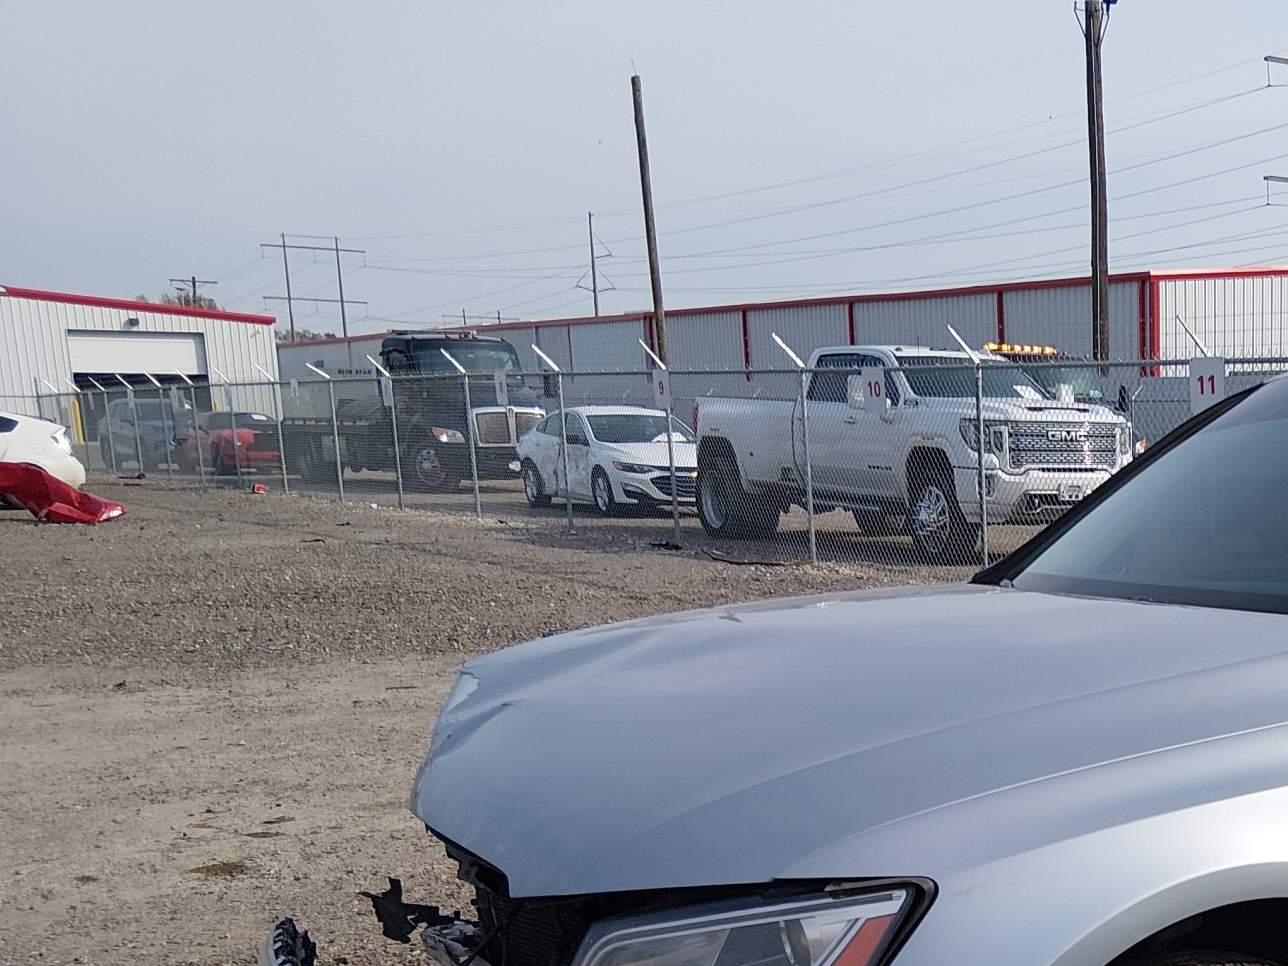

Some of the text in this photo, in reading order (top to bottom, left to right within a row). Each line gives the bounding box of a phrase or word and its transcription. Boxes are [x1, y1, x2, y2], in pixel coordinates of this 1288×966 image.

[658, 380, 665, 395] 9
[867, 380, 881, 398] 10
[1196, 374, 1216, 396] 11
[1047, 430, 1089, 442] GMC
